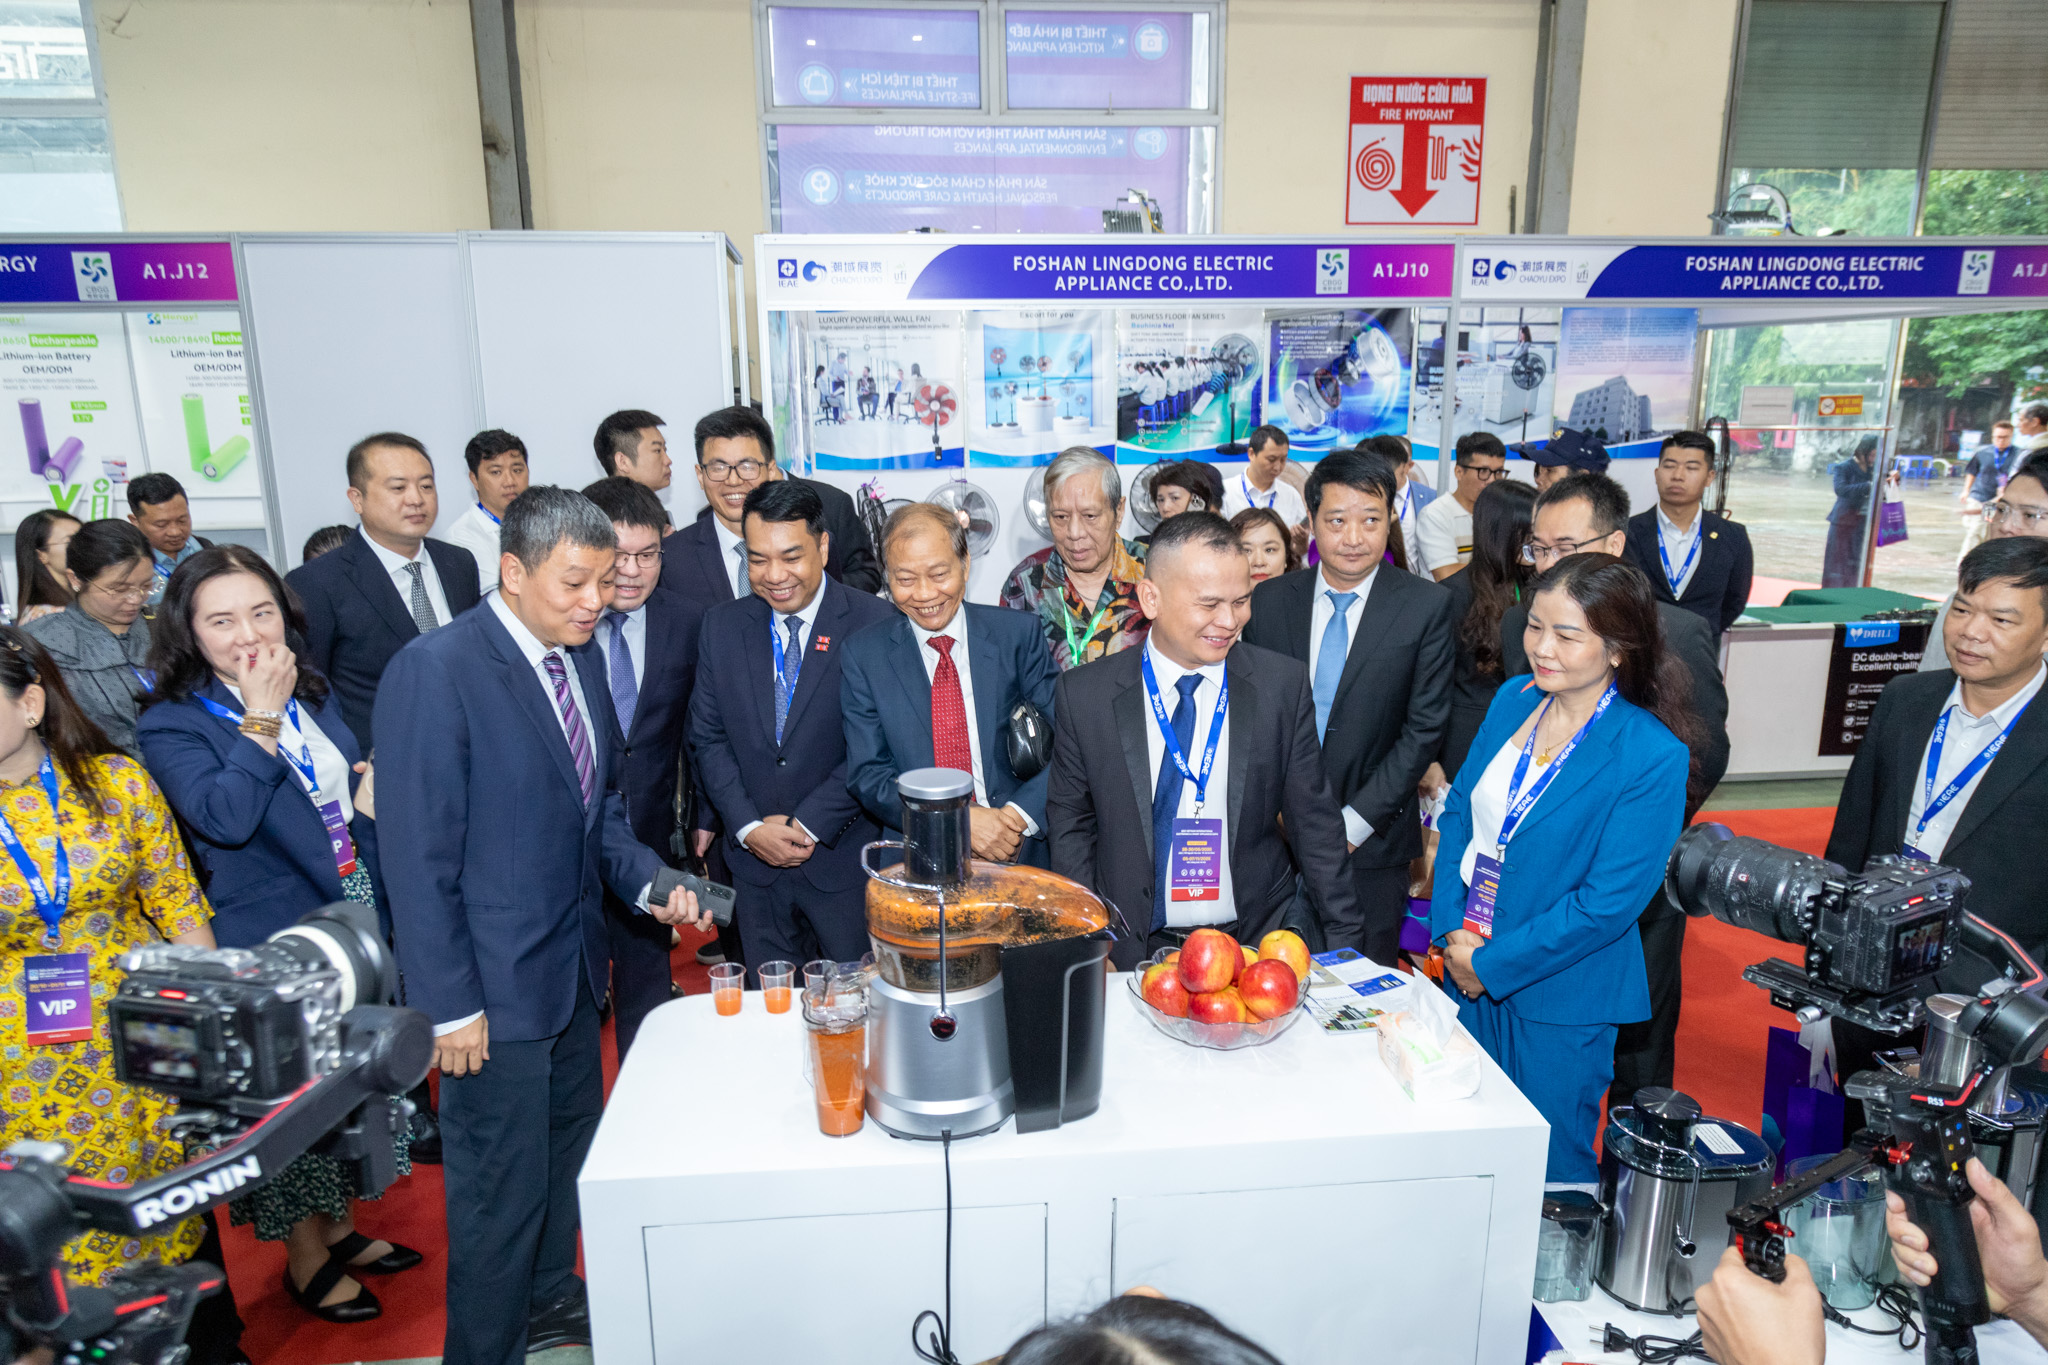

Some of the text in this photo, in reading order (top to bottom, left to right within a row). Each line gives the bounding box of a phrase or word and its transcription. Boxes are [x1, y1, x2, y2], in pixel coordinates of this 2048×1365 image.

[1363, 84, 1394, 106] HỌNG
[1380, 108, 1454, 120] FIRE HYDRANT
[143, 263, 209, 280] A1.J12
[1013, 256, 1274, 272] FOSHAN LINGDONG ELECTRIC
[1373, 262, 1429, 278] A1.J10
[1686, 256, 1924, 271] FOSHAN LINGDONG ELECTRIC
[778, 280, 800, 288] IEAE
[1054, 276, 1233, 292] APPLIANCE CO.,LTD.
[1472, 278, 1489, 286] IEAE
[1520, 275, 1566, 284] CHAOYU EXPO
[1721, 276, 1884, 292] APPLIANCE CO.,LTD.
[818, 316, 848, 324] LUXURY
[850, 316, 892, 324] POWERFUL
[893, 315, 915, 323] WALL
[31, 335, 98, 347] Rechargeable
[56, 352, 91, 362] Battery
[170, 350, 224, 358] Lithium-ion
[22, 366, 72, 374] OEM/ODM
[194, 364, 242, 372] OEM/ODM
[1853, 653, 1868, 662] DC
[1852, 662, 1892, 672] Excellent
[1152, 693, 1164, 716] IEAE
[1216, 693, 1227, 714] IEAE
[1600, 688, 1618, 708] IEAE
[1934, 724, 1946, 744] IEAE
[1558, 742, 1576, 762] IEAE
[1173, 751, 1187, 773] IEAE
[1202, 754, 1213, 776] IEAE
[1942, 784, 1959, 804] IEAE
[1516, 794, 1534, 814] IEAE
[1738, 873, 1747, 882] G
[1188, 888, 1204, 898] VIP
[38, 999, 77, 1016] VIP
[132, 1154, 262, 1228] RONIN
